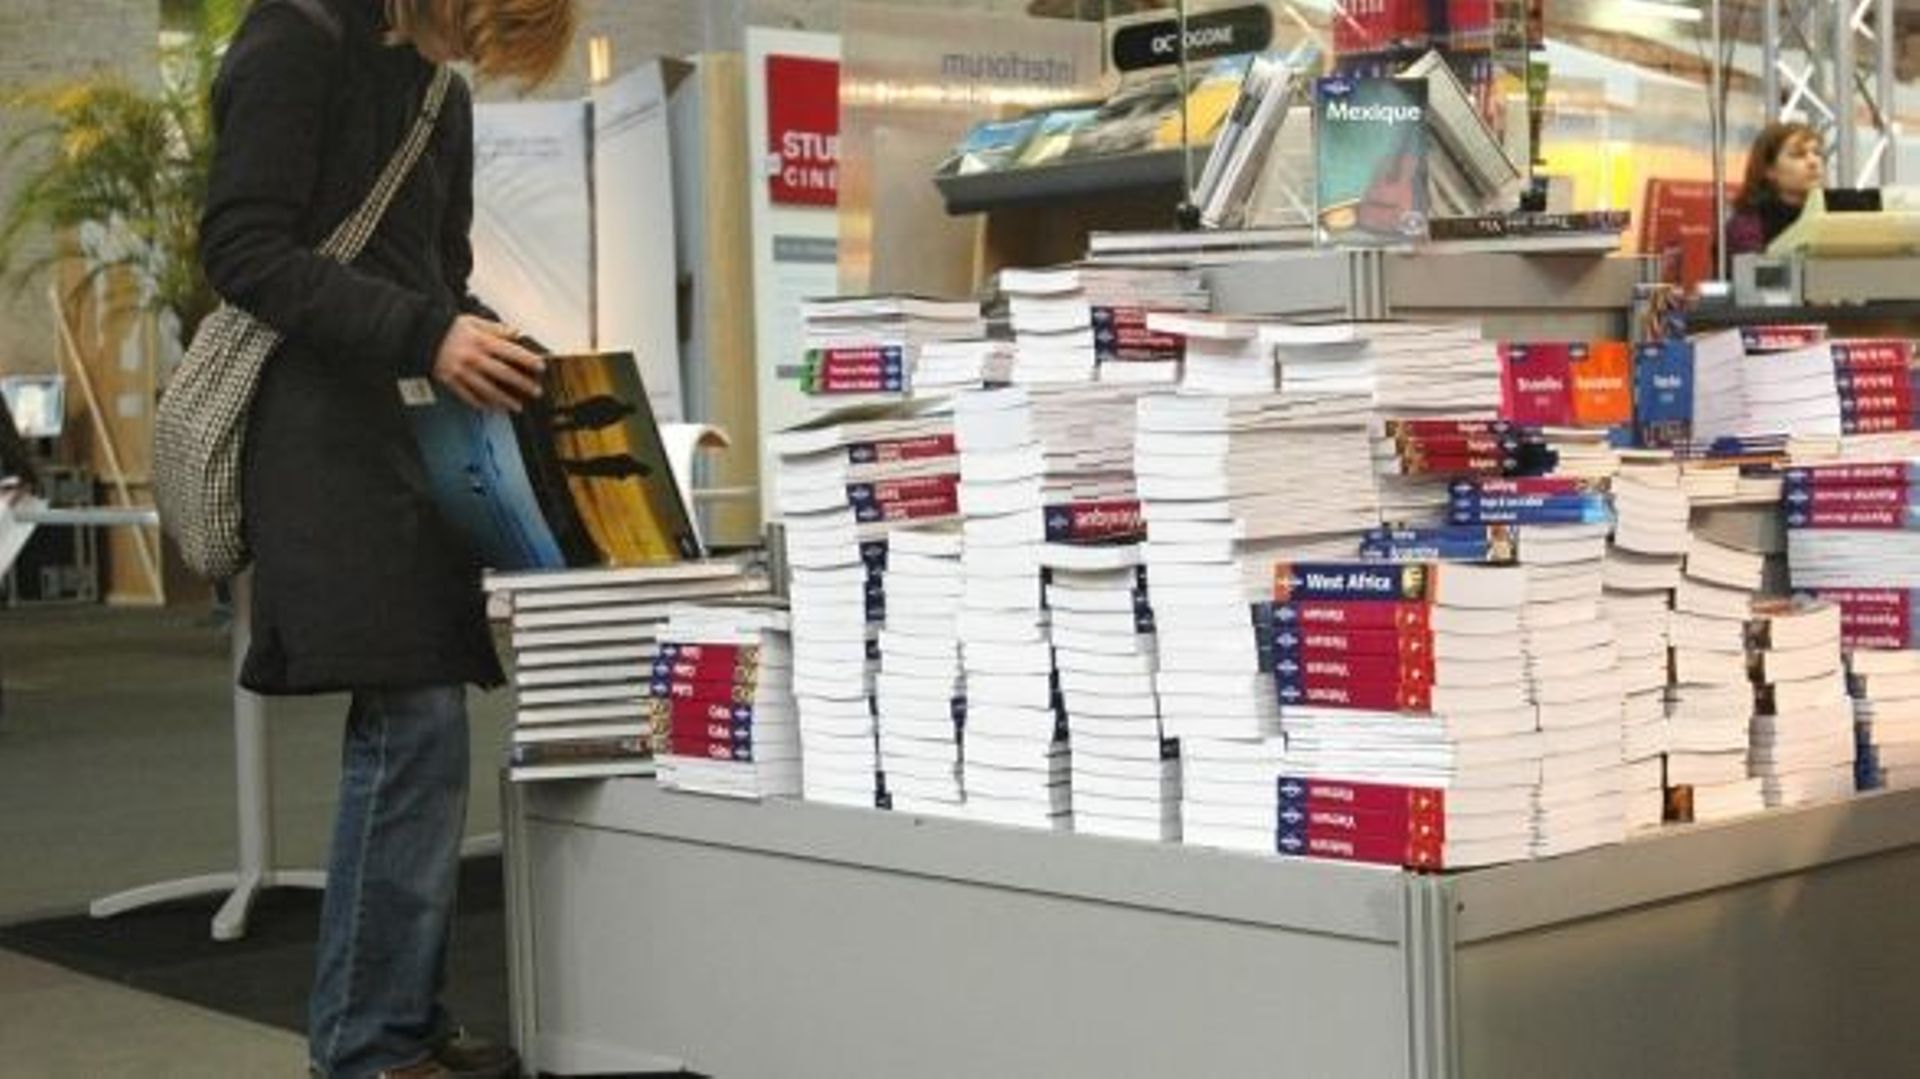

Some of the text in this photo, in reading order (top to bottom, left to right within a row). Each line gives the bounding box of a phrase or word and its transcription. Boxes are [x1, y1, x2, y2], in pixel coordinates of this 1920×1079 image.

[1152, 25, 1234, 53] OCOGONE
[1326, 101, 1421, 125] Mexique
[1305, 572, 1393, 592] West Africa
